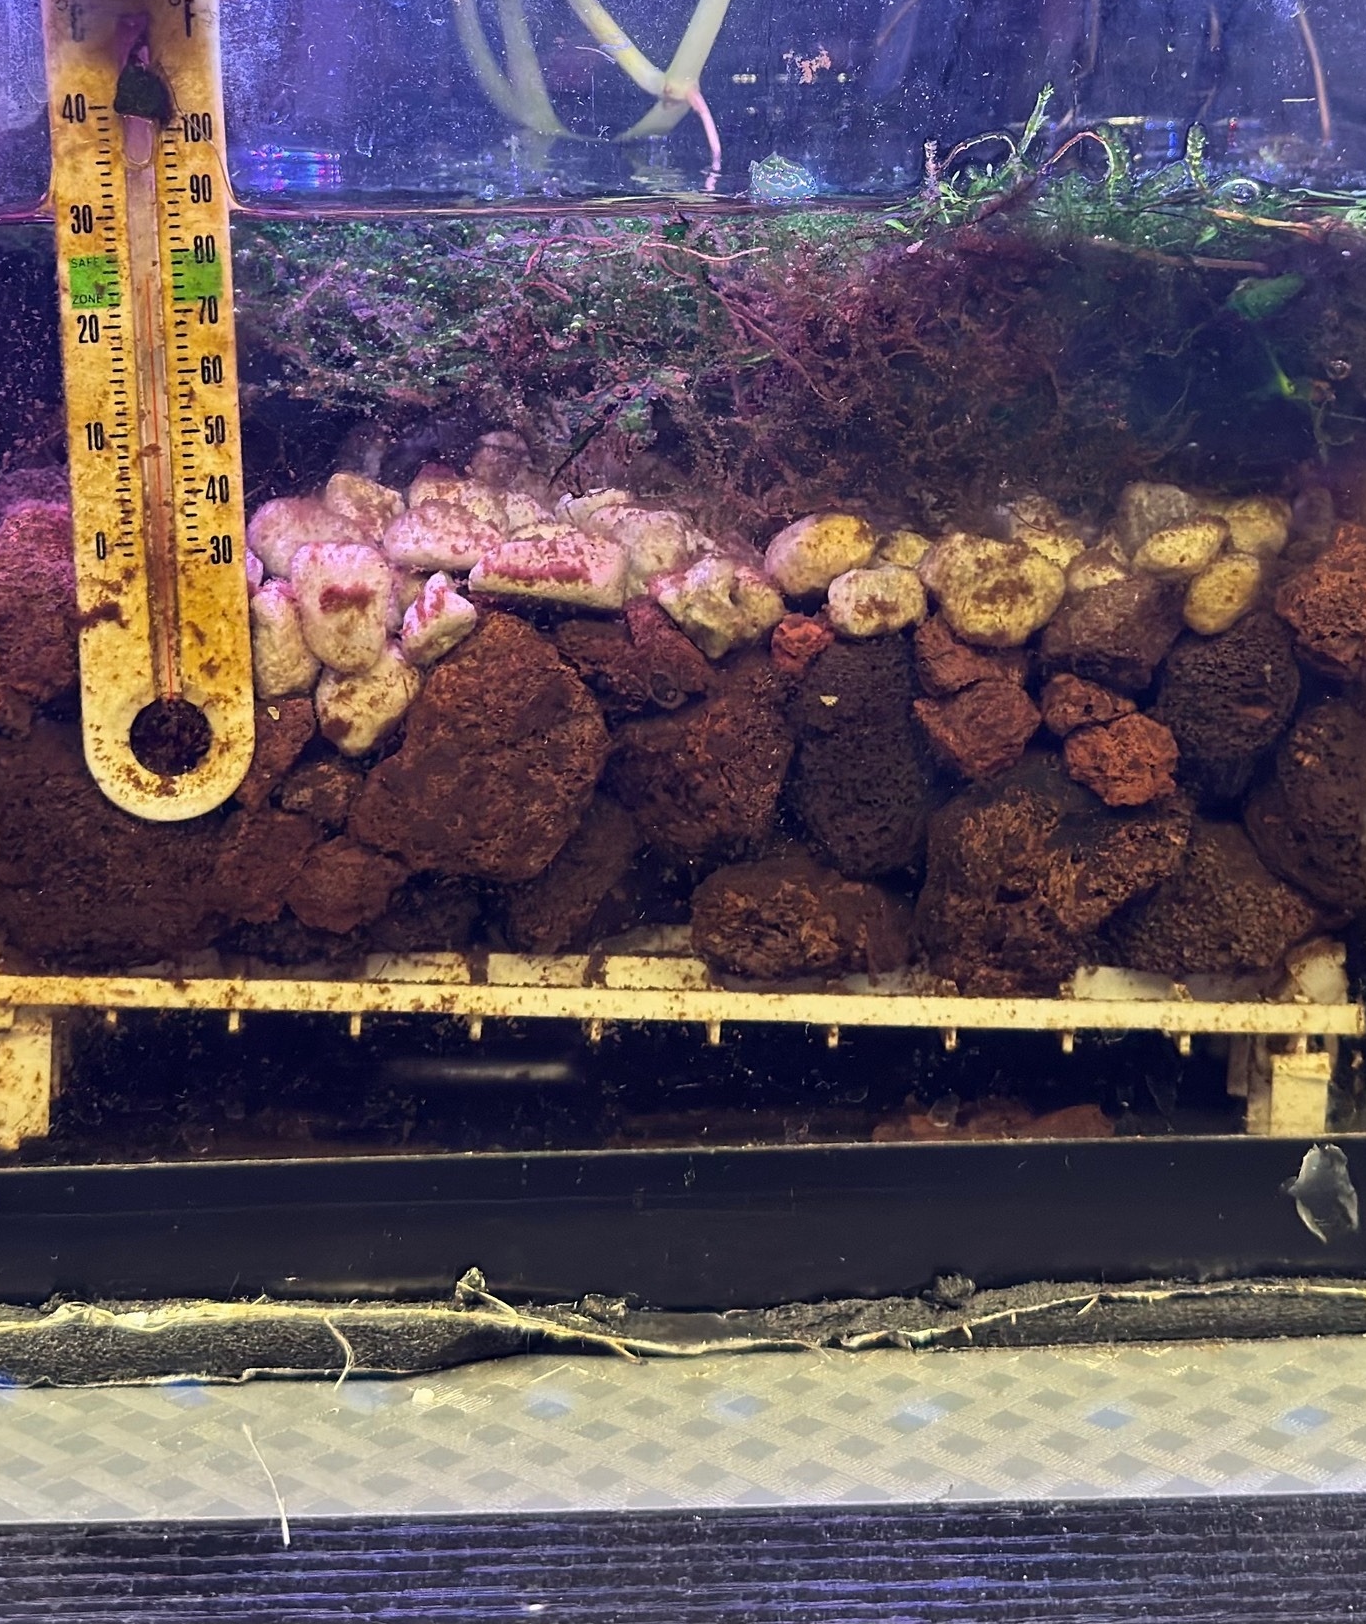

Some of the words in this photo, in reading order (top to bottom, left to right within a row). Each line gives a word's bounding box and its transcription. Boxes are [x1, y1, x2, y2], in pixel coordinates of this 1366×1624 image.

[62, 93, 87, 124] 40
[181, 112, 213, 143] 100
[189, 174, 212, 204] 90
[70, 204, 94, 234] 30
[70, 256, 100, 269] SAFE
[193, 235, 216, 264] 80
[72, 294, 103, 305] ZONE
[197, 296, 219, 325] 70
[77, 314, 100, 344] 20
[201, 355, 223, 384] 60
[85, 422, 104, 451] 10
[204, 415, 226, 444] 50
[205, 475, 230, 504] 40
[96, 531, 107, 560] 0
[210, 535, 233, 565] 30
